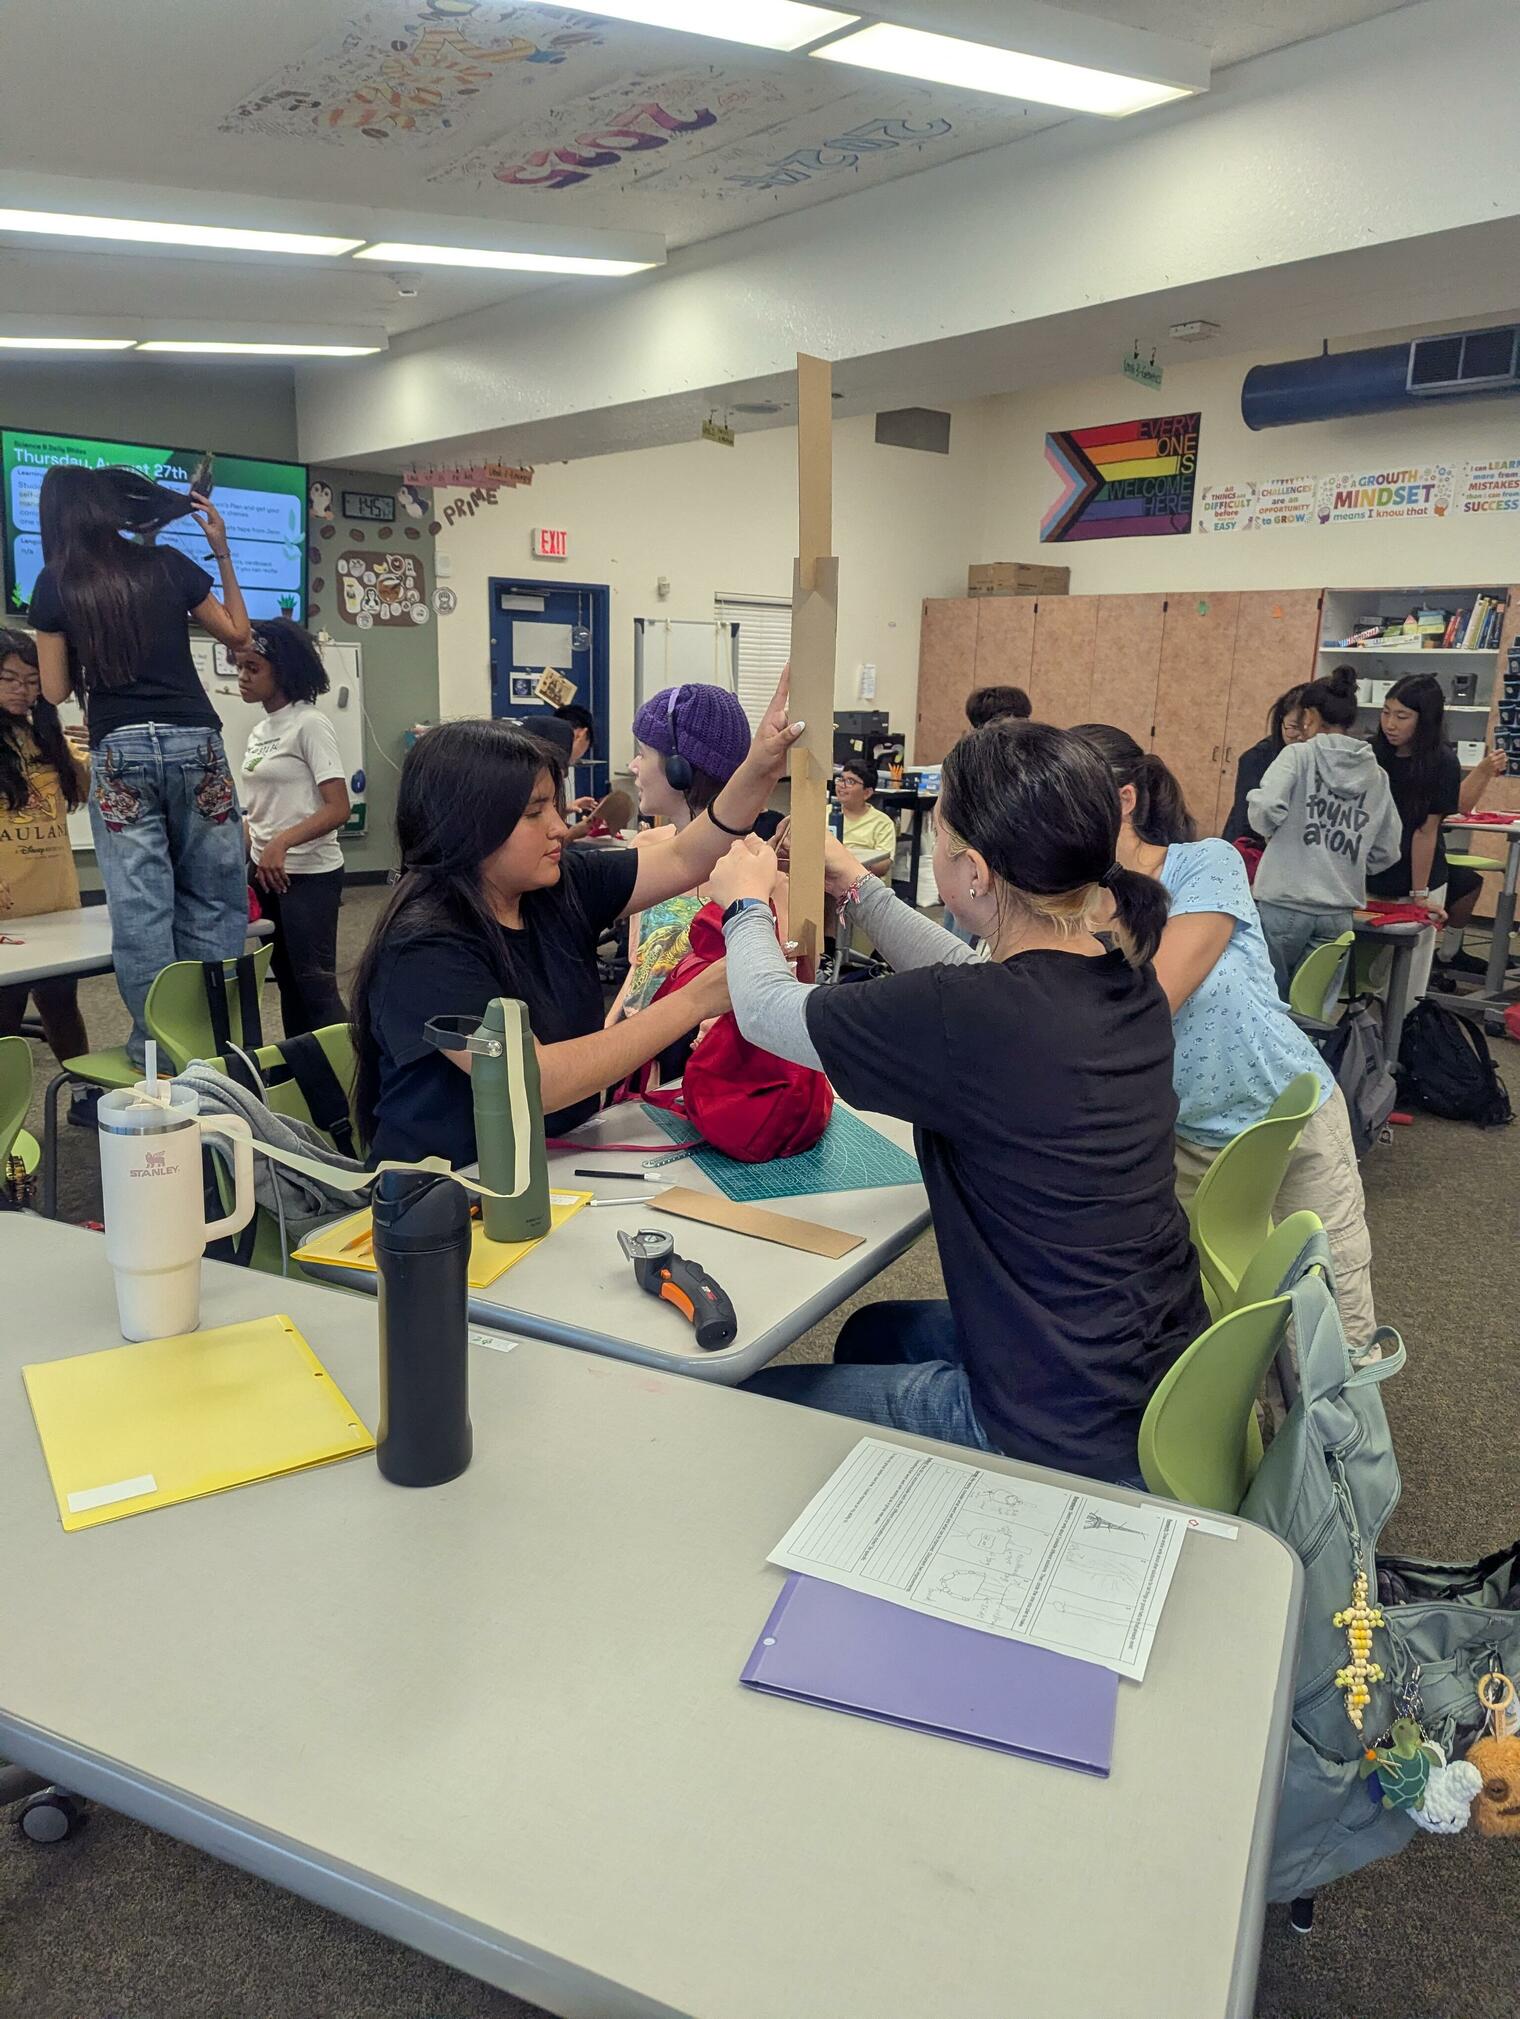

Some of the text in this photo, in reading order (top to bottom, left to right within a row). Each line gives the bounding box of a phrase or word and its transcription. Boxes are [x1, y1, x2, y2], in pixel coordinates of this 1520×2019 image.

[494, 103, 718, 190] 2025
[724, 117, 951, 191] 2024
[1139, 414, 1198, 438] EVERY
[1156, 433, 1197, 456] ONE
[154, 464, 188, 480] 27th
[1176, 454, 1195, 474] IS
[1108, 474, 1193, 498] WELCOME
[1358, 469, 1419, 487] GROWTH
[1211, 492, 1236, 500] THINGS
[1261, 485, 1312, 497] CHALLENGES
[1333, 484, 1436, 510] MINDSET
[443, 488, 498, 526] PRIME
[1142, 495, 1191, 515] HERE
[1203, 499, 1252, 511] DIFFICULT
[1214, 510, 1239, 518] before
[1259, 504, 1311, 514] OPPORTUNITY
[1333, 506, 1428, 521] means I know that
[1463, 499, 1519, 513] SUCCESS
[1213, 521, 1237, 531] EASY
[541, 529, 567, 555] EXIT
[130, 1165, 179, 1177] STANLEY
